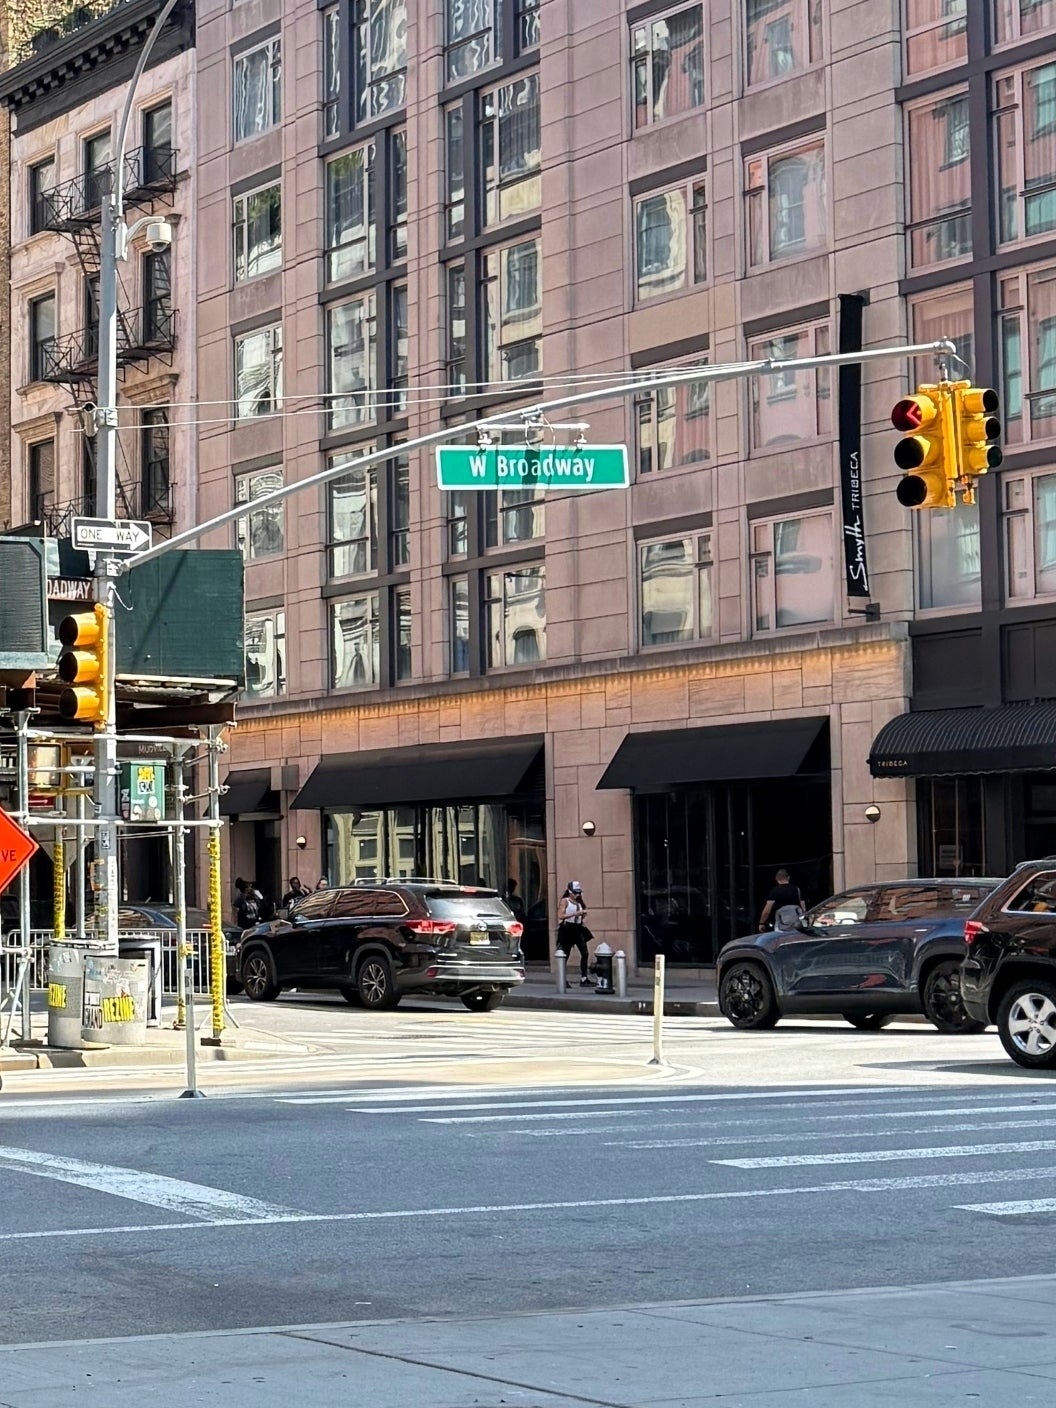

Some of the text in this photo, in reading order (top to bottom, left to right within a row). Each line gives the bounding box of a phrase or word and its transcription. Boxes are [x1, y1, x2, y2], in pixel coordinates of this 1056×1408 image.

[469, 454, 595, 482] W Broadway
[80, 528, 139, 542] ONE WAY
[844, 451, 868, 591] Smyth TRIBECA
